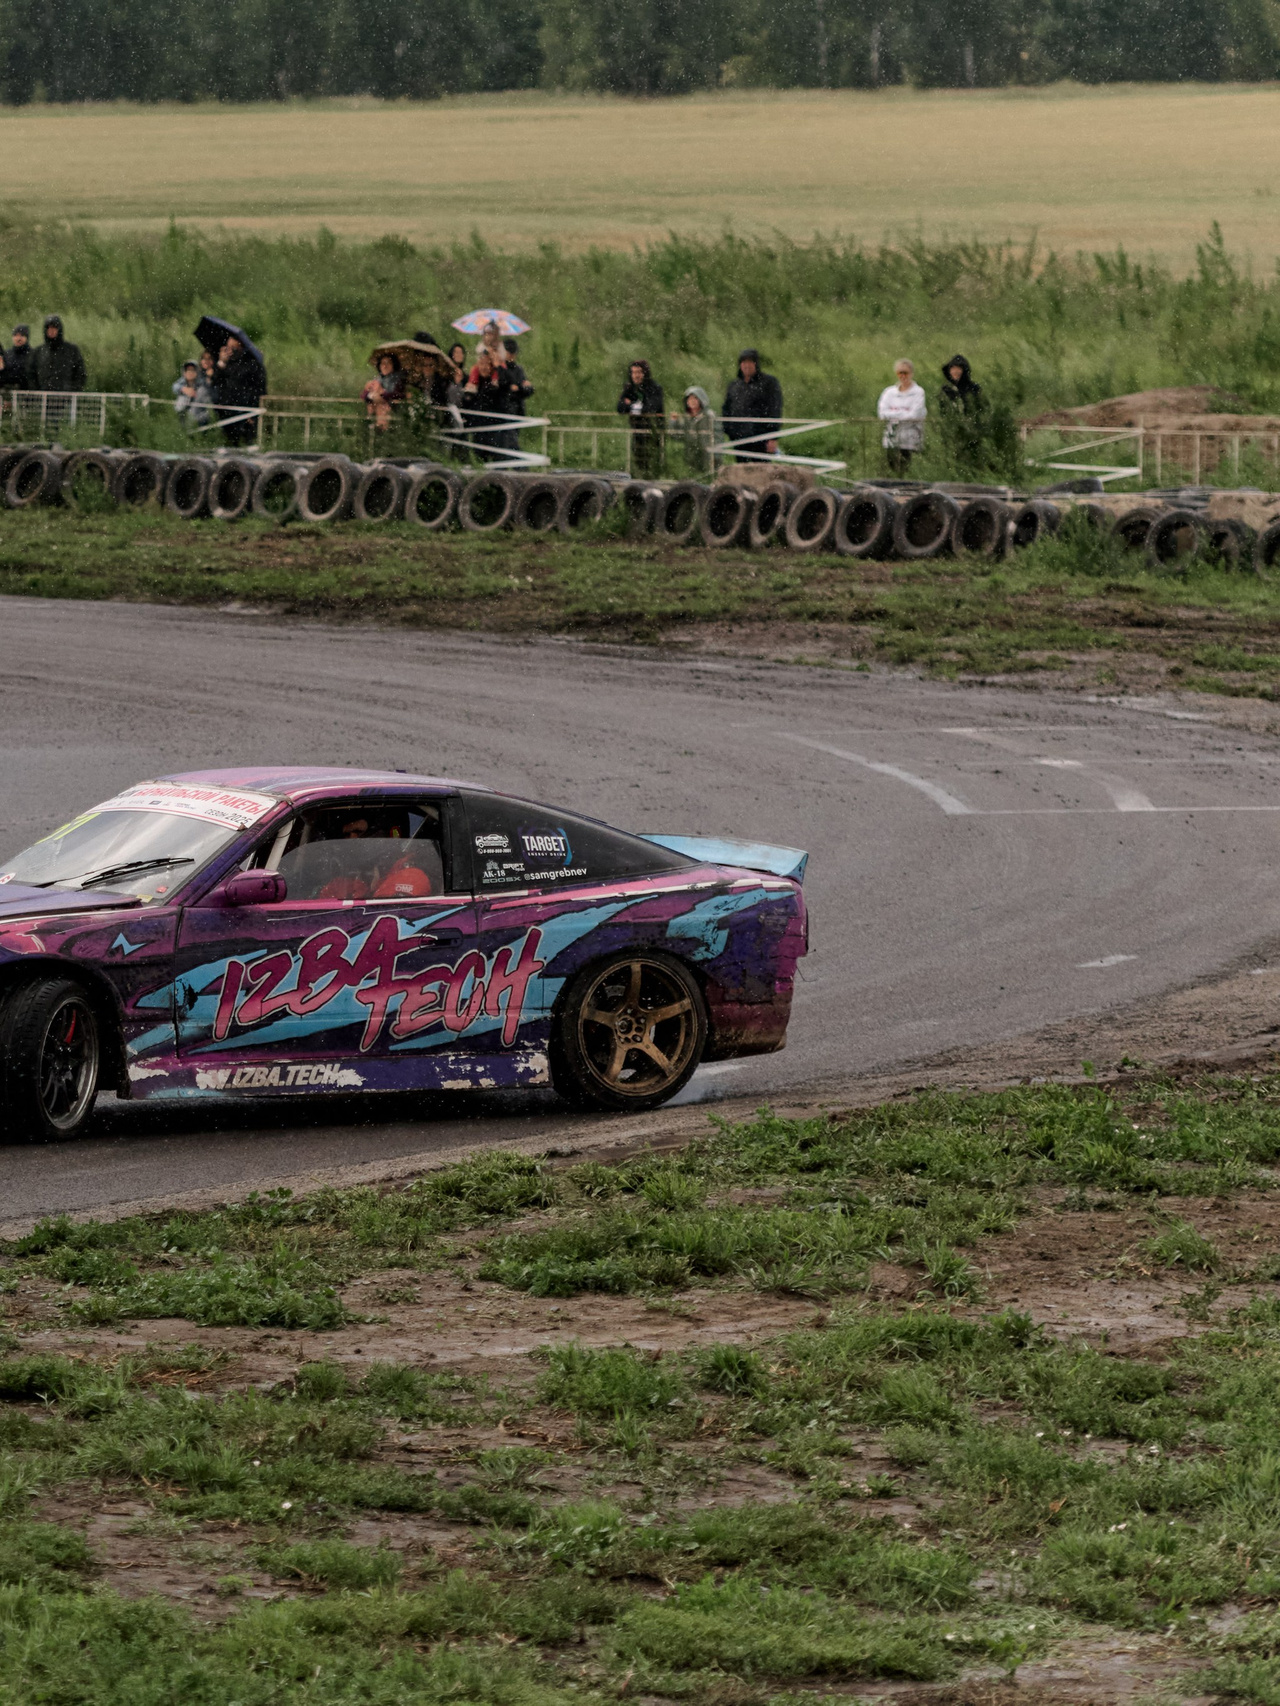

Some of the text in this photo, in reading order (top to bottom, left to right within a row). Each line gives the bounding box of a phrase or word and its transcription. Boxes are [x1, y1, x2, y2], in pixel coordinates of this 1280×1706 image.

[212, 792, 270, 815] РАКЕТЫ
[224, 813, 253, 825] 2025
[522, 835, 566, 852] TARGET
[483, 869, 506, 878] AK-18
[395, 884, 414, 893] OMP
[212, 915, 438, 1042] IZBA
[356, 926, 547, 1052] TECH
